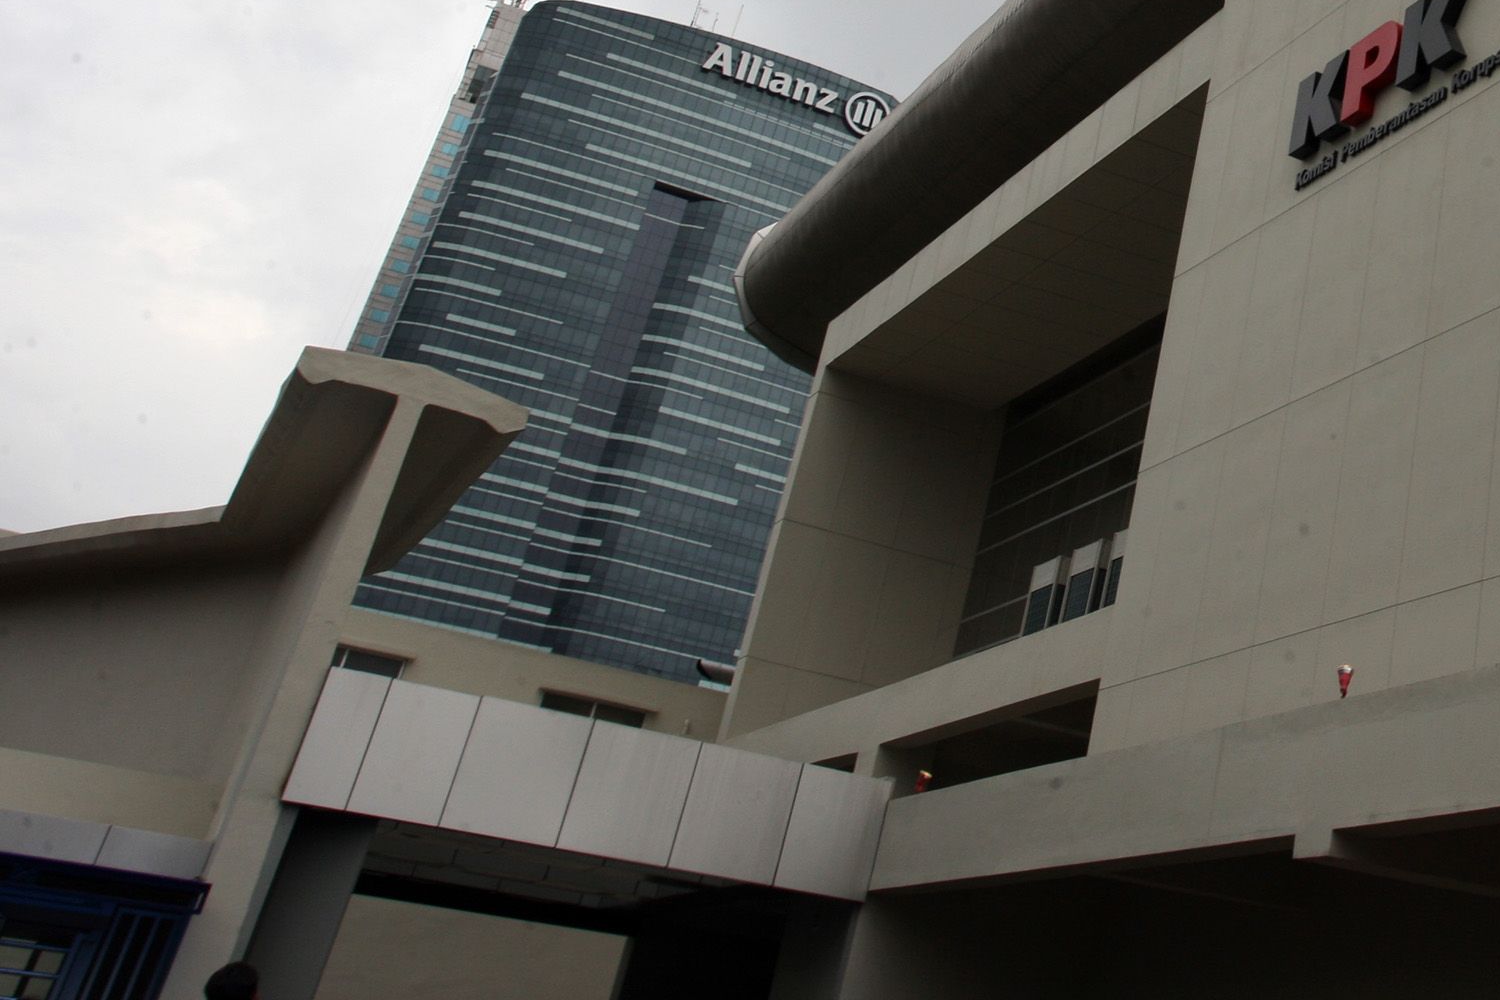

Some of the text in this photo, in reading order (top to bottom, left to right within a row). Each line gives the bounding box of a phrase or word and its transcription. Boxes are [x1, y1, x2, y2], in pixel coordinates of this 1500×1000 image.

[702, 42, 838, 114] Allianz
[1295, 150, 1338, 191] Komisi
[1340, 86, 1446, 163] Pemberantasan
